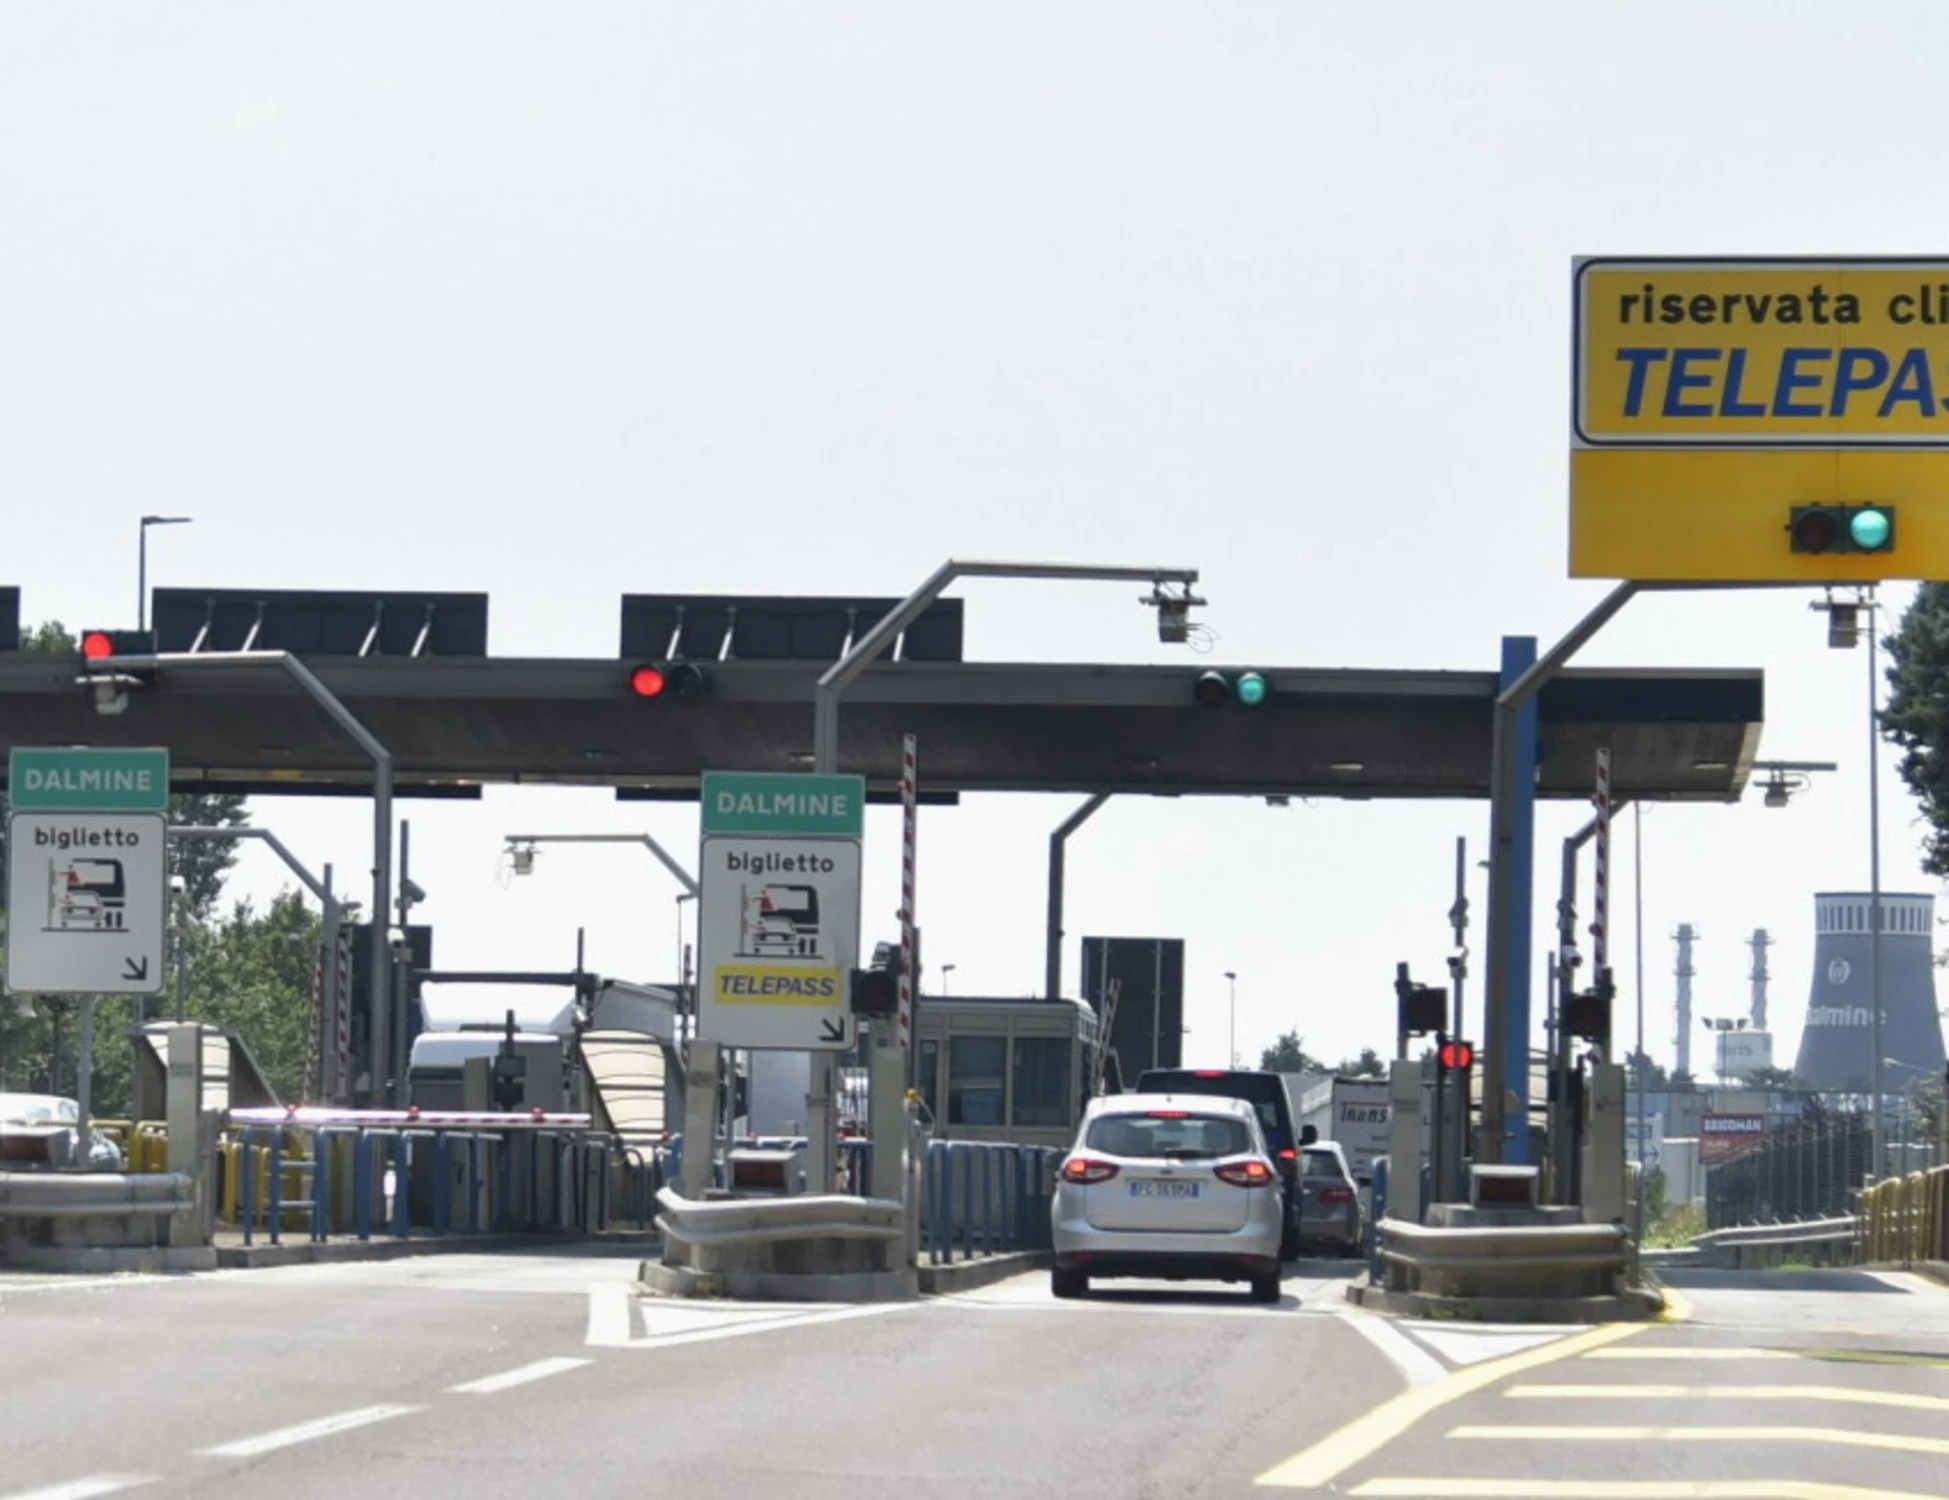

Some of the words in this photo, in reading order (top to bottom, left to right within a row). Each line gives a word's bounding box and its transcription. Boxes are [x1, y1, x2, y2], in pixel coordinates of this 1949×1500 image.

[1619, 284, 1862, 325] riservata
[1615, 347, 1949, 418] TELEPA
[24, 768, 153, 791] DALMINE
[716, 791, 849, 817] DALMINE
[34, 827, 140, 849] biglietto
[727, 852, 835, 875] biglietto
[720, 974, 836, 997] TELEPASS
[1806, 1003, 1888, 1027] almine
